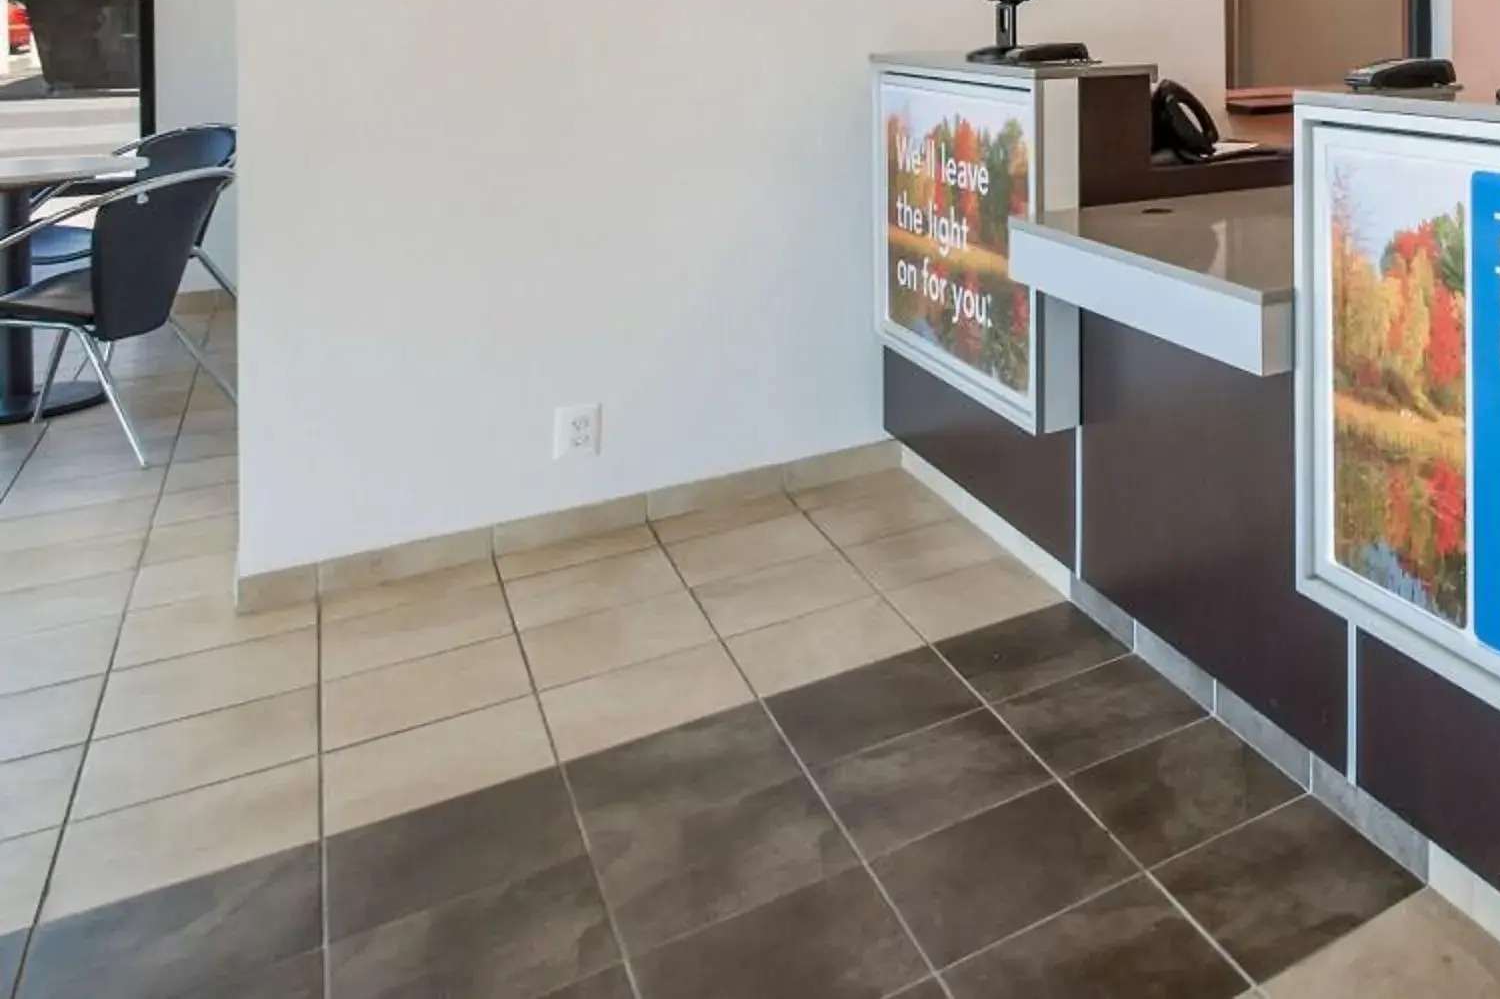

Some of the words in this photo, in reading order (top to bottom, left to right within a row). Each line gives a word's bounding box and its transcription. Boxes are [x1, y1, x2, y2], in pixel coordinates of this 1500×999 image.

[895, 133, 935, 178] We'll
[941, 142, 990, 195] leave
[896, 190, 923, 234] the
[927, 200, 970, 256] light
[897, 258, 918, 291] on
[921, 256, 947, 304] for
